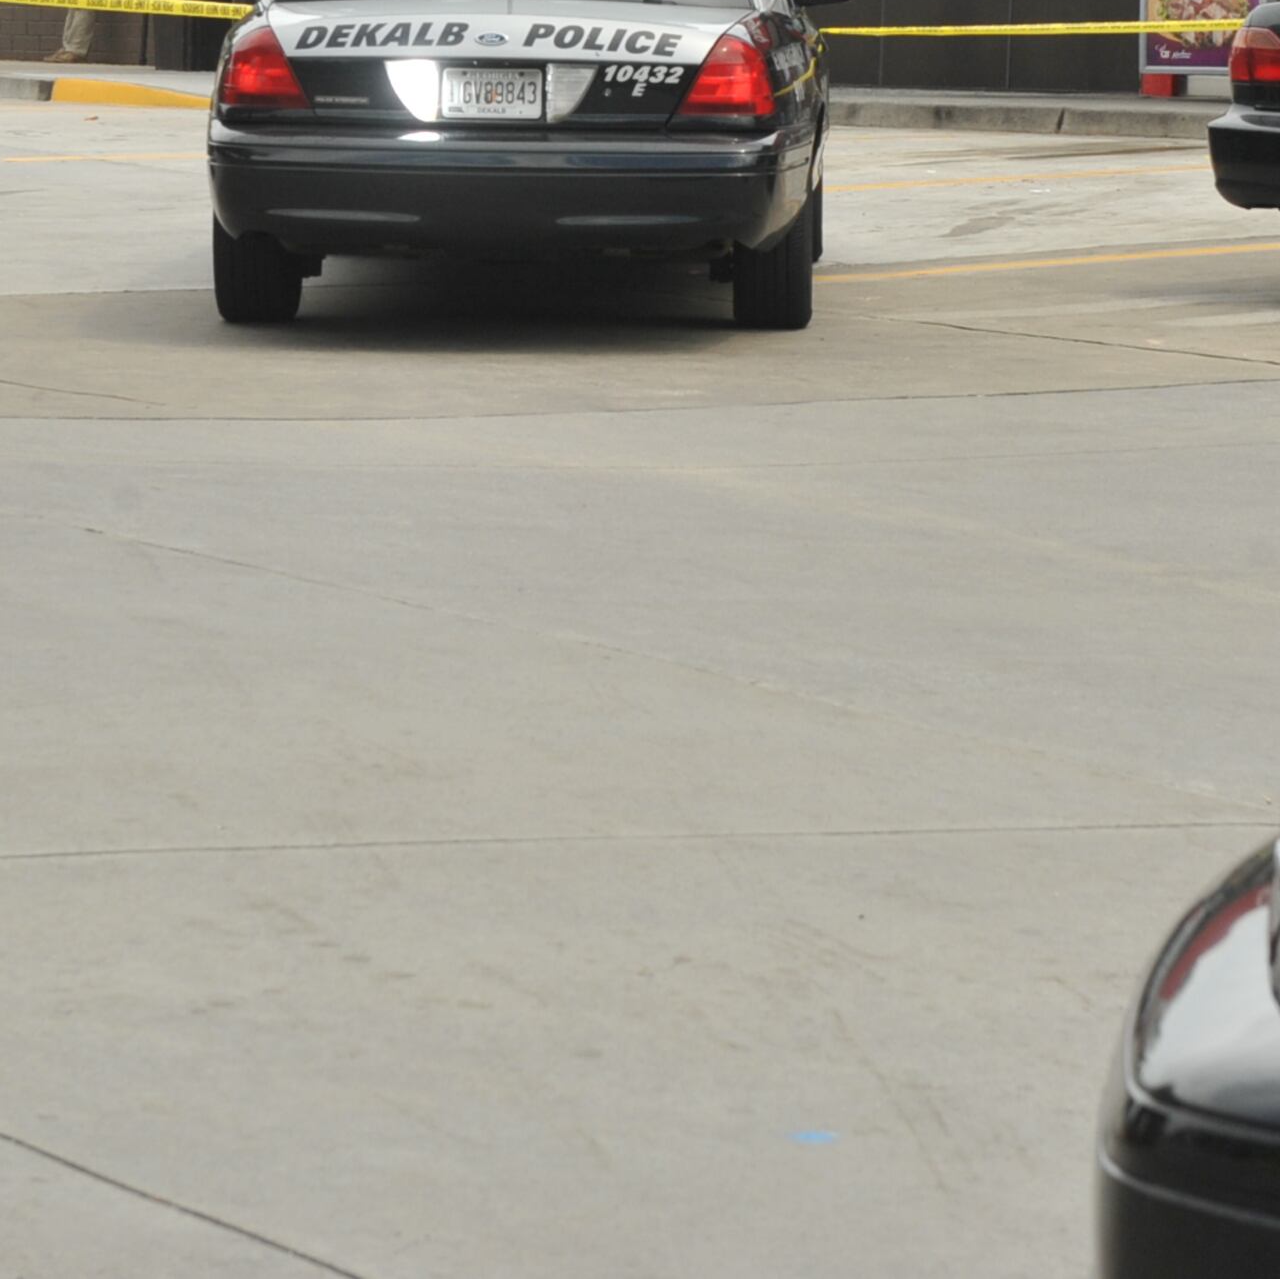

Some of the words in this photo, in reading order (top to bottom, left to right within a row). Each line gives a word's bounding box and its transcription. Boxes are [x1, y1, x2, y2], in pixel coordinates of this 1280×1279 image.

[294, 22, 470, 50] DEKALB
[523, 23, 682, 57] POLICE
[604, 65, 684, 84] 10432
[463, 81, 537, 105] GV89843
[631, 83, 646, 98] E
